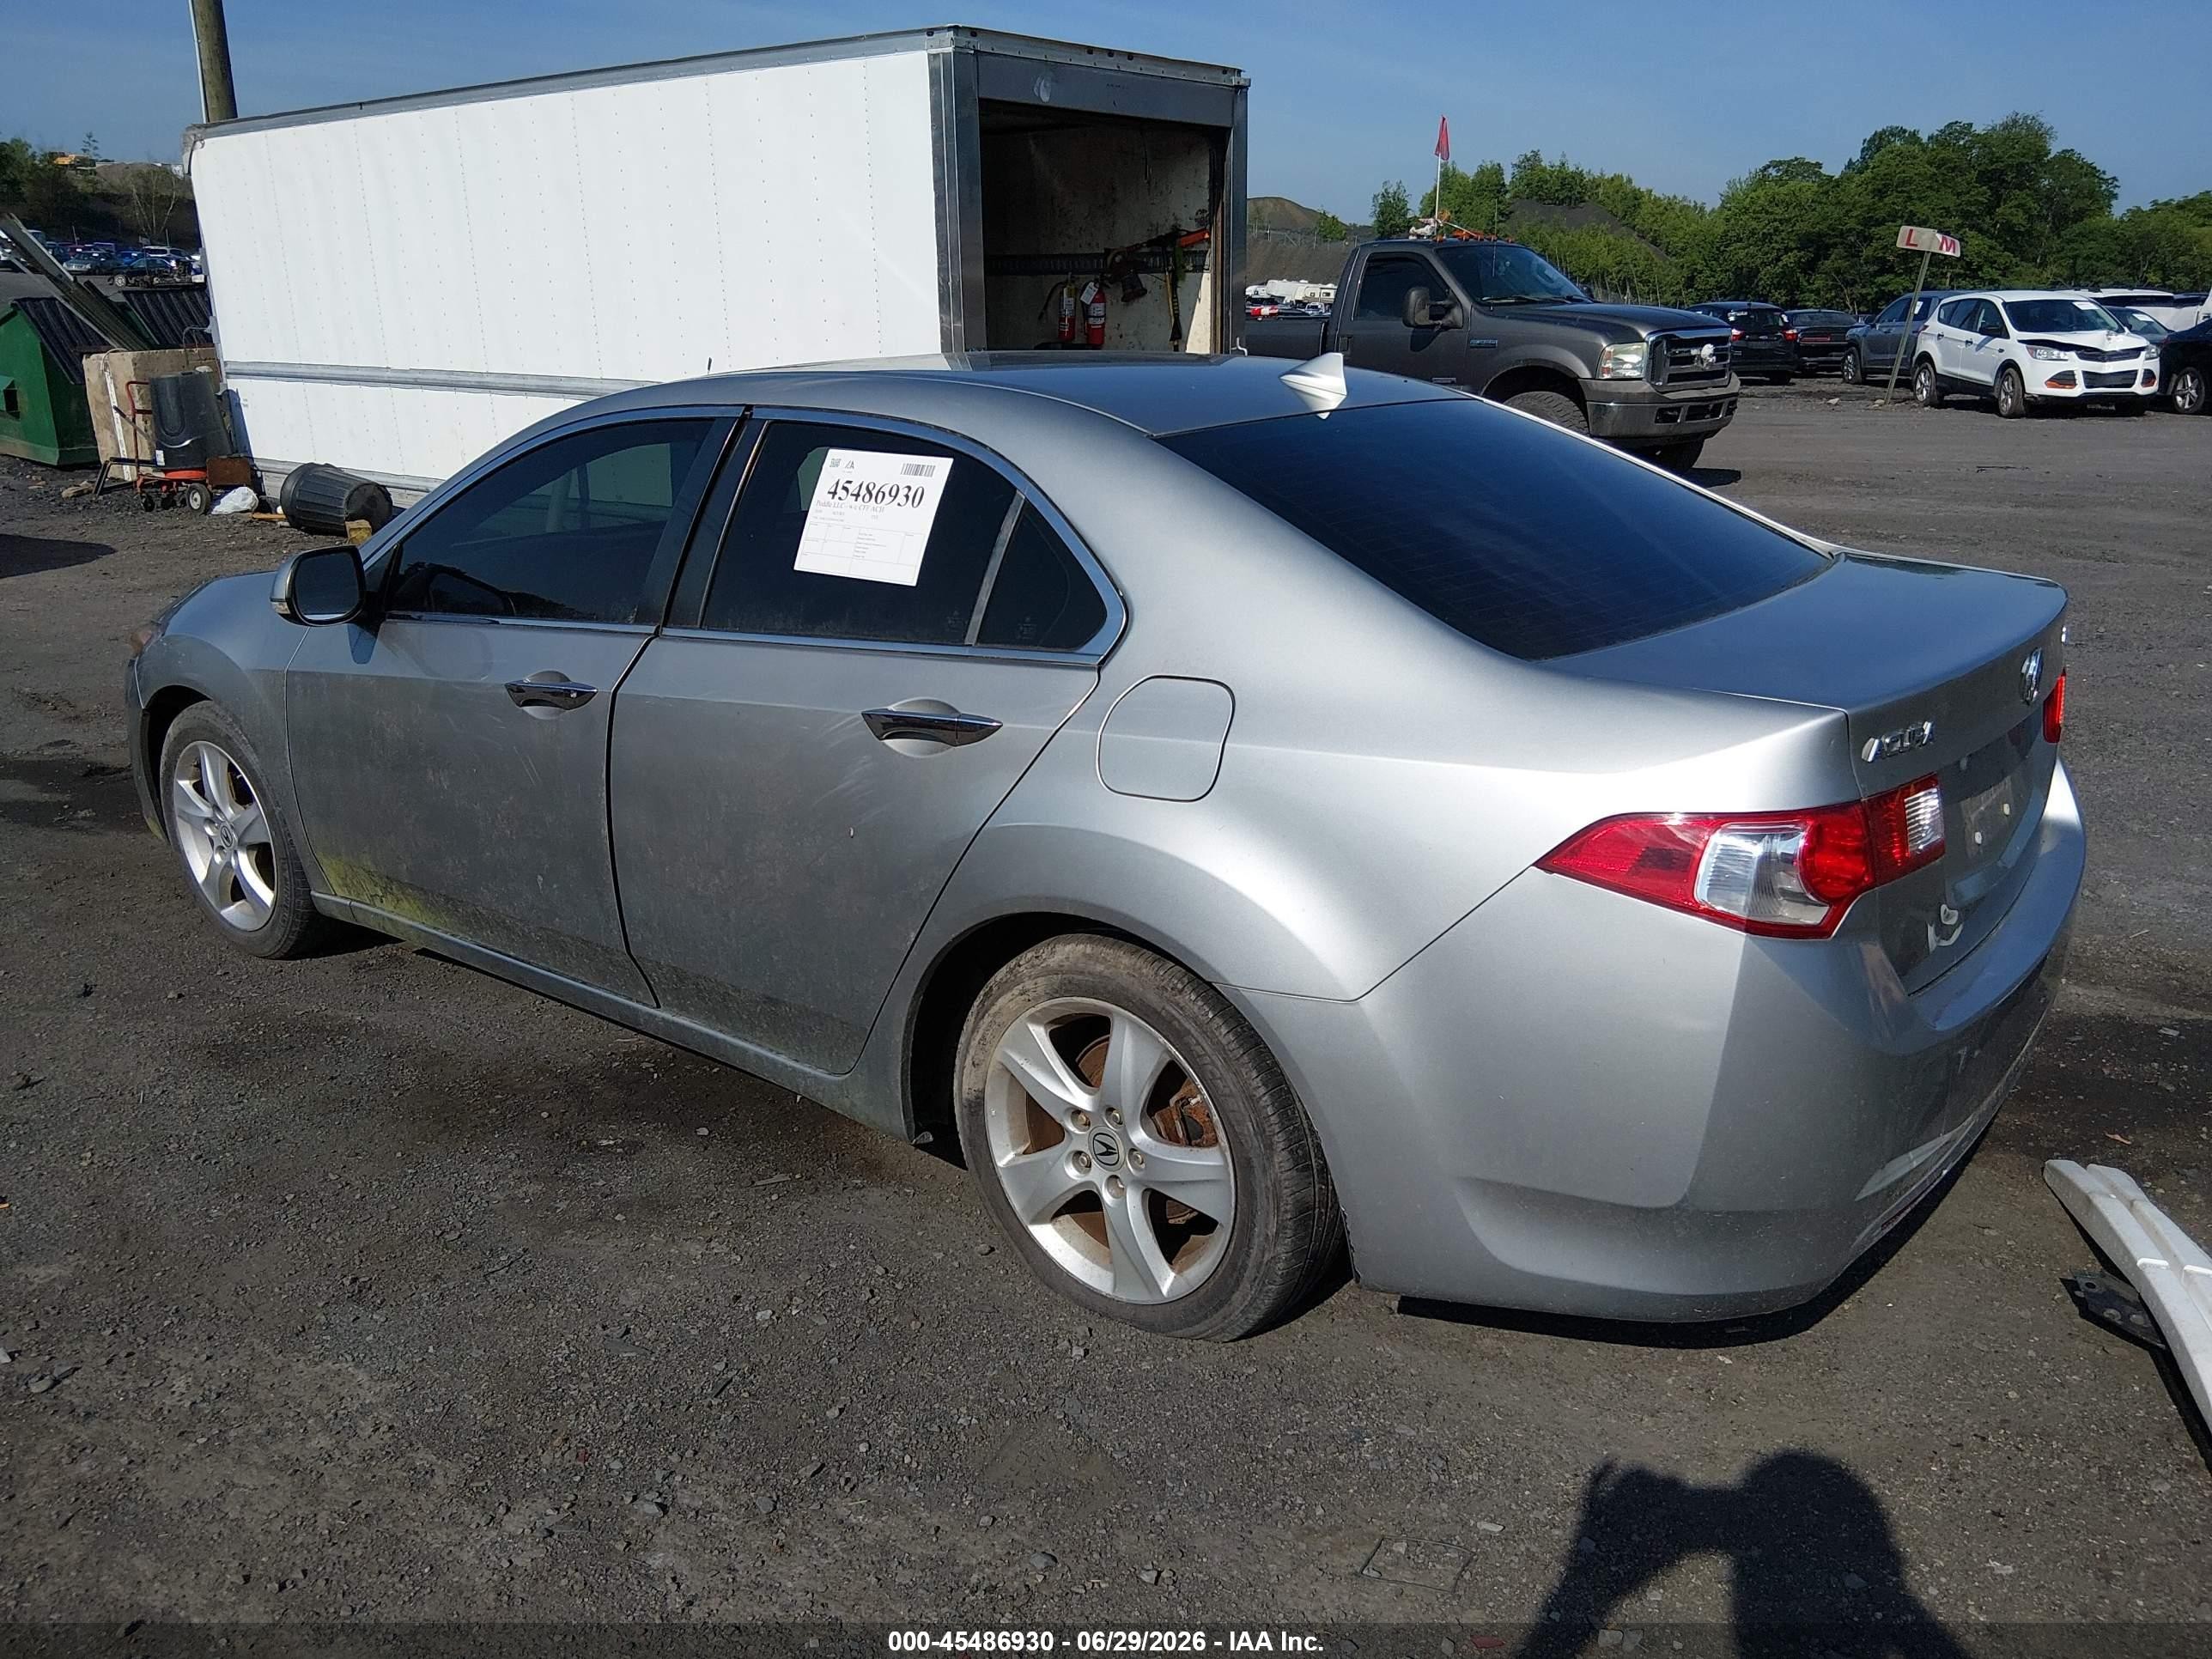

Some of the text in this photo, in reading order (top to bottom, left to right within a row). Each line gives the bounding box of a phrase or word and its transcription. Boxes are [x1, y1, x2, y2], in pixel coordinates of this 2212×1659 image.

[1905, 228, 1956, 254] L M
[827, 478, 925, 508] 45486930
